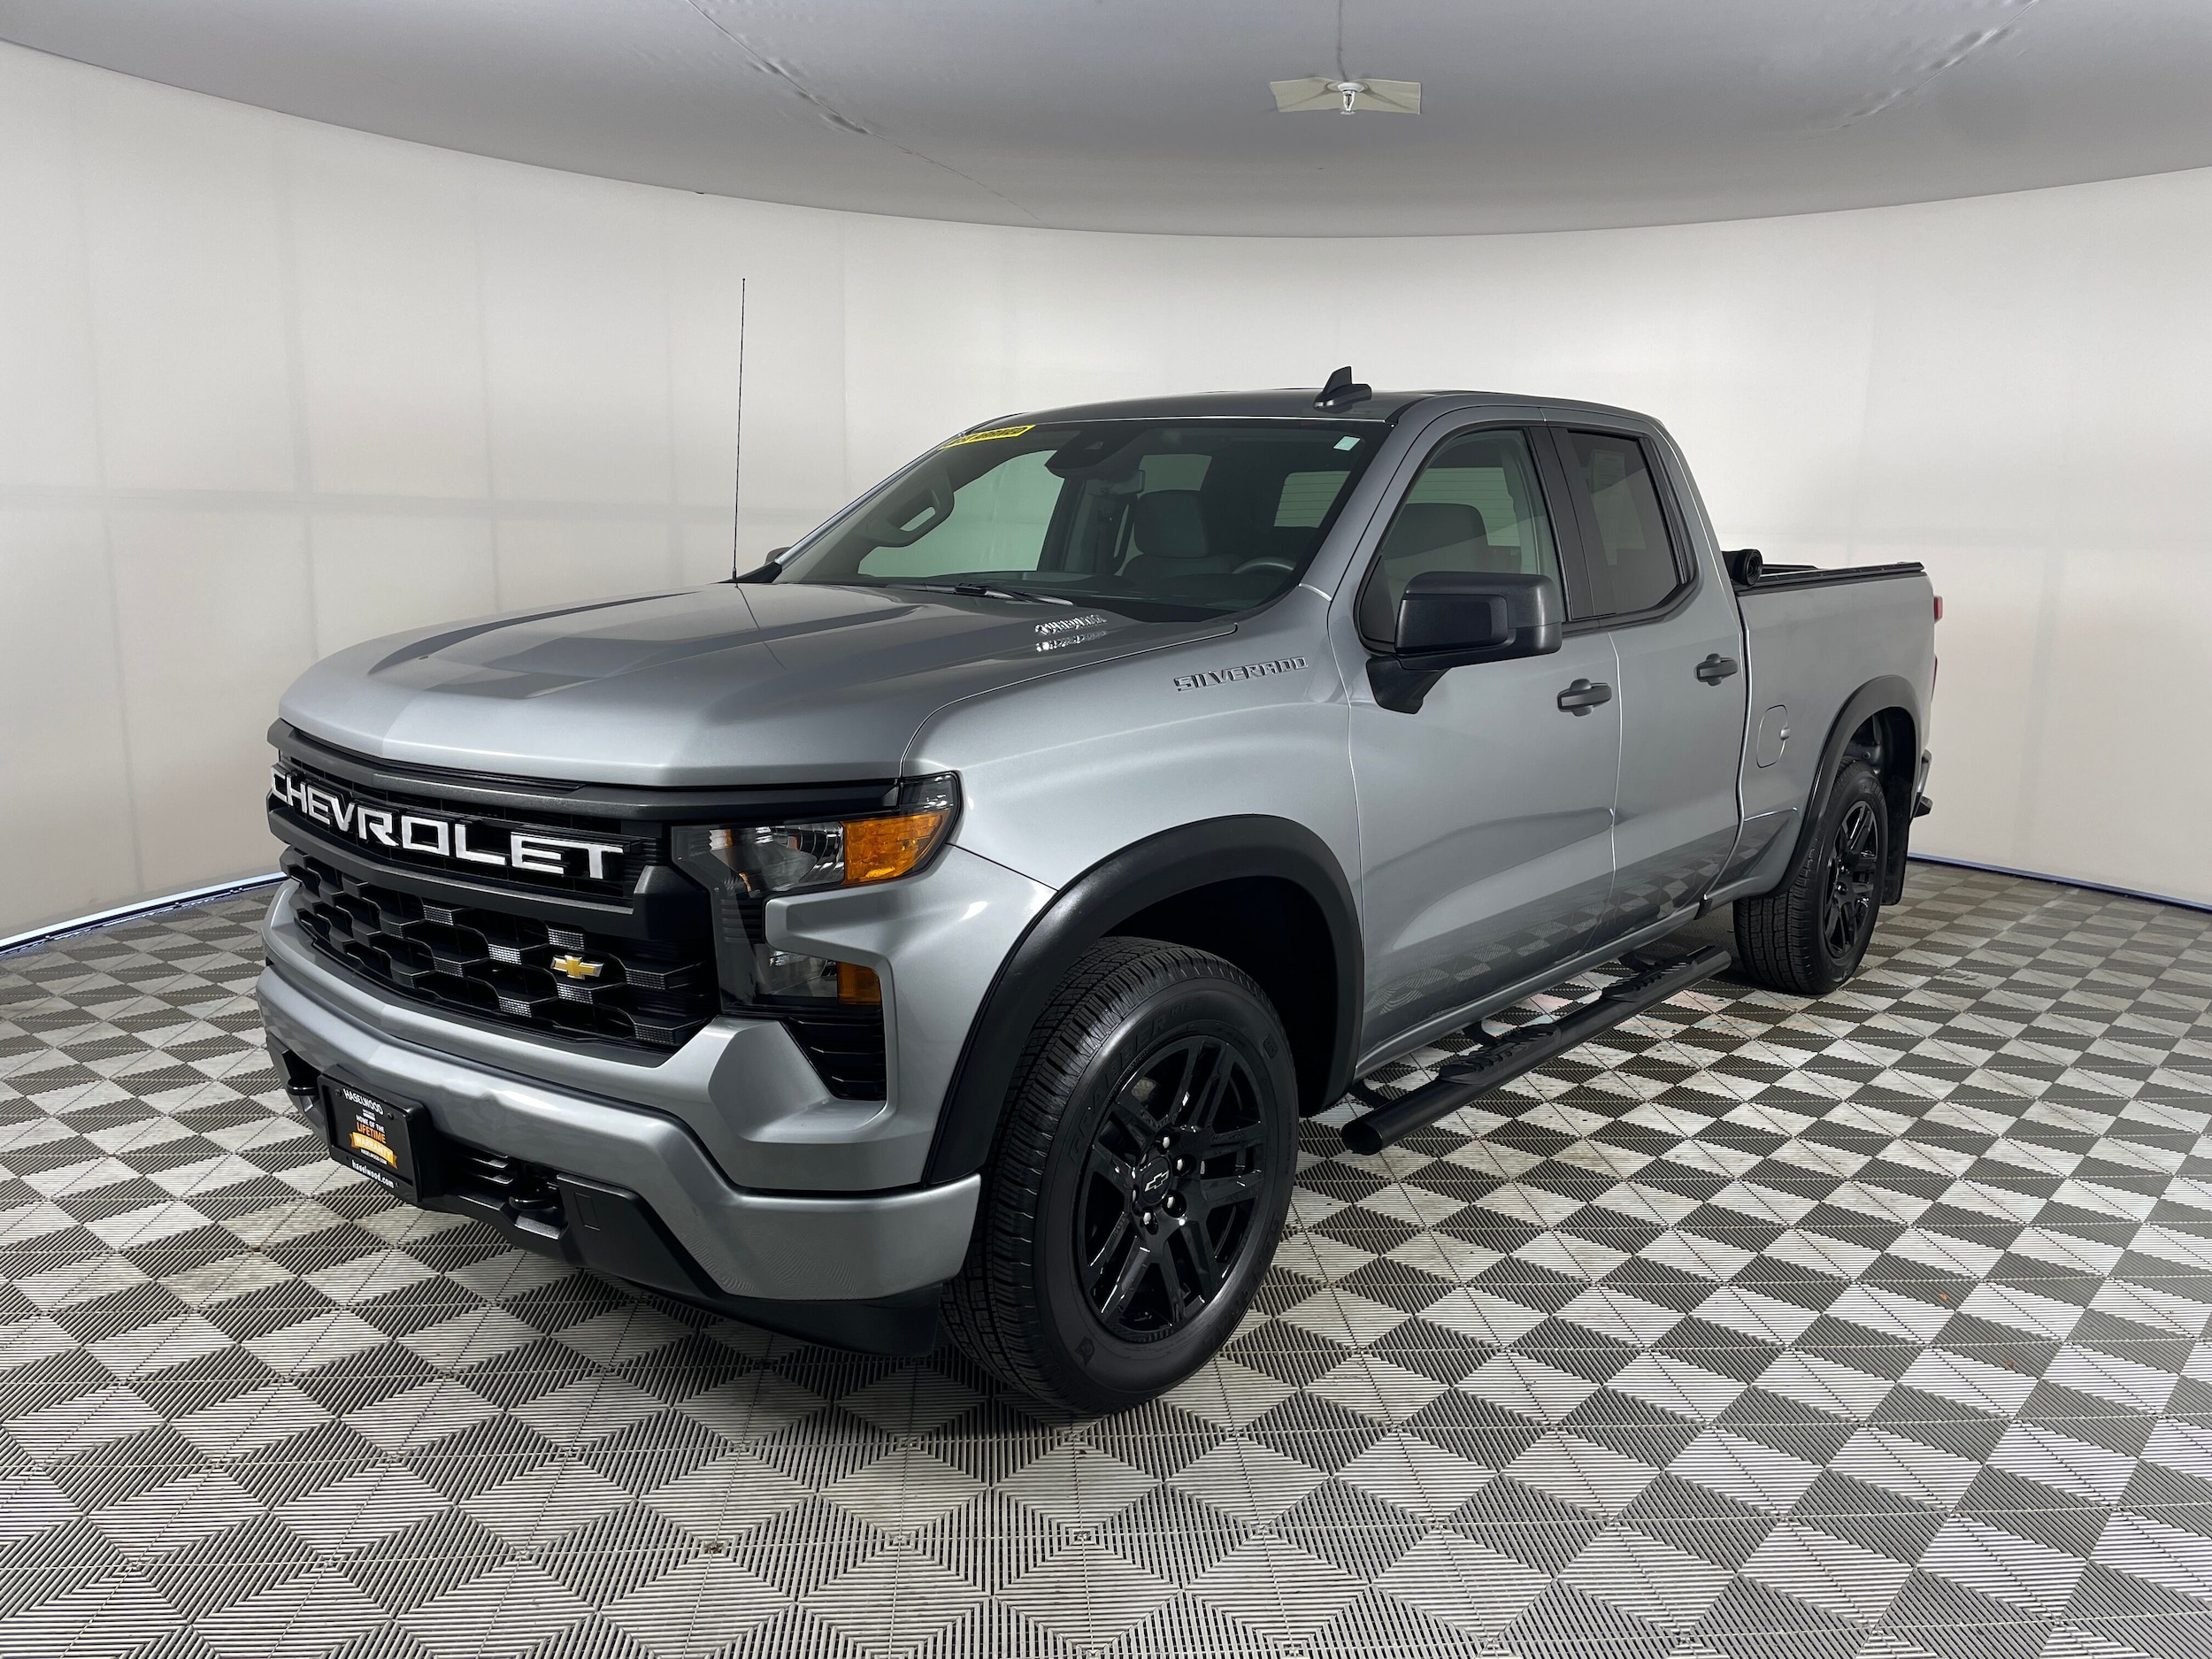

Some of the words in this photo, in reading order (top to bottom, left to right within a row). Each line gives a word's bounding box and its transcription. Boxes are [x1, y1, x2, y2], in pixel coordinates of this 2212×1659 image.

[1173, 656, 1309, 692] SILVERADO
[271, 765, 624, 879] CHEVROLET
[342, 1088, 384, 1115] HASELWOOD
[356, 1115, 369, 1126] HOME
[369, 1120, 375, 1129] OF
[376, 1124, 386, 1133] THE
[357, 1121, 387, 1144] LIFETIME
[355, 1134, 392, 1160] WARRANTY
[351, 1159, 395, 1188] haselwood.com
